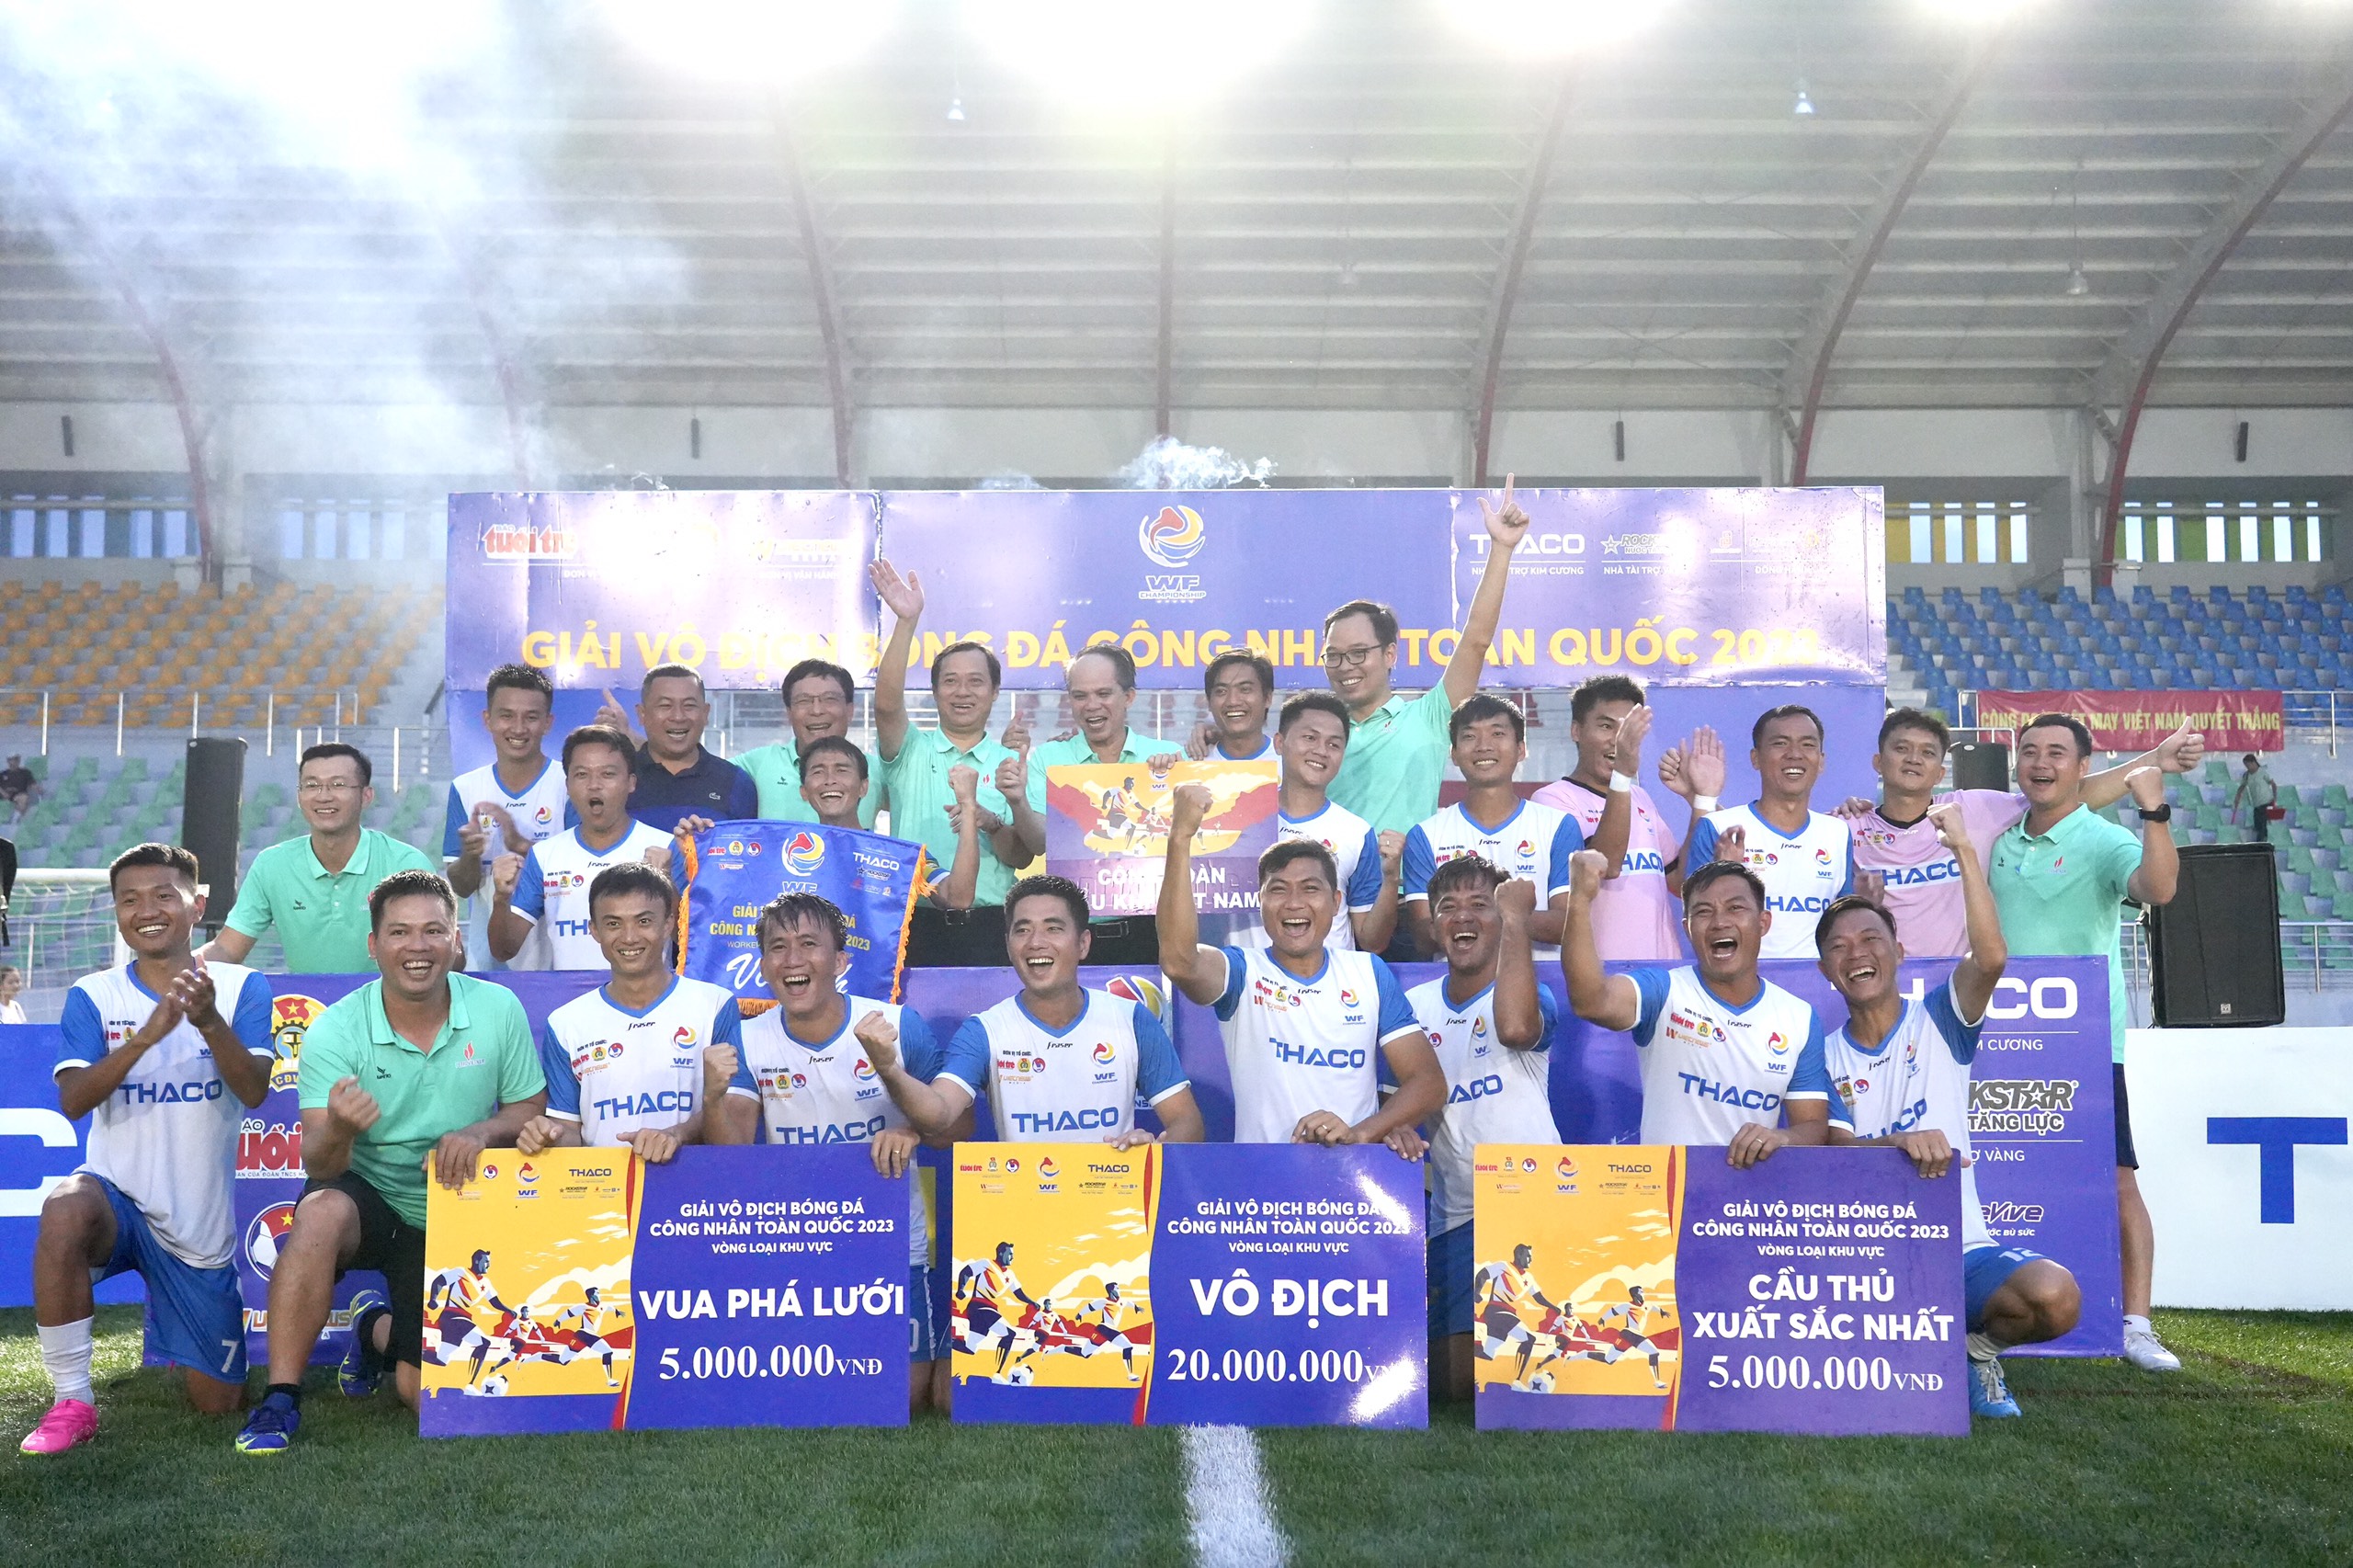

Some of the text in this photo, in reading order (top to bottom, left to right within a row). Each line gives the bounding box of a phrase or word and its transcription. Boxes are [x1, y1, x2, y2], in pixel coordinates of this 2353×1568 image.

[1469, 533, 1586, 554] TACO
[1530, 567, 1548, 575] KIM
[1549, 566, 1585, 575] CƯƠNG
[1603, 565, 1623, 575] NHÀ
[1624, 565, 1641, 575] TÀI
[1145, 575, 1200, 592] WF
[1139, 591, 1207, 599] CHAMPIONSHIP
[521, 620, 622, 670] GIẢI
[633, 622, 708, 671] VÔ
[854, 630, 994, 669] BN
[1006, 619, 1073, 668] ĐÁ
[1549, 614, 1699, 666] QUỐC
[1980, 709, 2018, 730] CÔNG
[2090, 712, 2119, 731] MAY
[2123, 709, 2151, 733] VIỆT
[2190, 706, 2233, 733] QUYẾT
[852, 851, 900, 871] THACO
[1881, 858, 1961, 887] HACO
[732, 902, 758, 918] GIẢI
[1766, 896, 1831, 914] HAC
[710, 920, 744, 936] CÔNG
[846, 933, 870, 951] 2023
[1268, 1037, 1367, 1069] THACO
[1987, 1038, 2044, 1051] CƯƠNG
[1094, 1072, 1116, 1080] WF
[1768, 1062, 1788, 1072] WF
[117, 1078, 223, 1105] THACO
[856, 1086, 880, 1098] WF
[1448, 1074, 1504, 1105] ACO
[1677, 1071, 1780, 1112] THACO
[593, 1090, 694, 1121] THACO
[776, 1115, 886, 1145] THACO
[1011, 1107, 1120, 1133] THACO
[1970, 1110, 2065, 1136] TĂNG LỰC
[1985, 1146, 2026, 1163] VÀNG
[569, 1168, 612, 1177] THACO
[1087, 1165, 1130, 1173] THACO
[1608, 1164, 1652, 1173] THACO
[2207, 1117, 2347, 1223] T
[679, 1197, 865, 1219] GIẢI VÔ ĐỊCH BÓNG ĐÁ
[1197, 1198, 1231, 1215] GIẢI
[1234, 1198, 1259, 1216] VÔ
[1262, 1201, 1302, 1219] ĐỊCH
[1306, 1198, 1354, 1216] BÓNG
[1722, 1199, 1917, 1222] GIẢI VÔ ĐỊCH BÓNG ĐÁ
[1980, 1201, 2044, 1224] eVive
[650, 1215, 894, 1237] CÔNG NHÂN TOÀN QUỐC 2023
[1167, 1216, 1217, 1234] CÔNG
[1220, 1217, 1267, 1234] NHÂN
[1271, 1217, 1316, 1234] TOÀN
[1320, 1216, 1370, 1235] QUỐC
[1692, 1218, 1949, 1239] CÔNG NHÂN TOÀN QUỐC 2023
[2003, 1227, 2016, 1236] BÙ
[2018, 1227, 2036, 1237] SỨC
[711, 1241, 833, 1256] VÒNG LOẠI KHU VỰC
[1228, 1239, 1349, 1256] VÒNG LOẠI KHU VỰC
[1756, 1242, 1885, 1260] VÒNG LOẠI KHU VỰC
[1748, 1266, 1895, 1302] CẦU THỦ
[638, 1277, 904, 1320] VUA PHÁ LƯỚI
[1189, 1267, 1389, 1329] VÔ ĐỊCH
[1692, 1303, 1954, 1342] XUẤT SẮC NHẤT
[221, 1340, 240, 1373] 7
